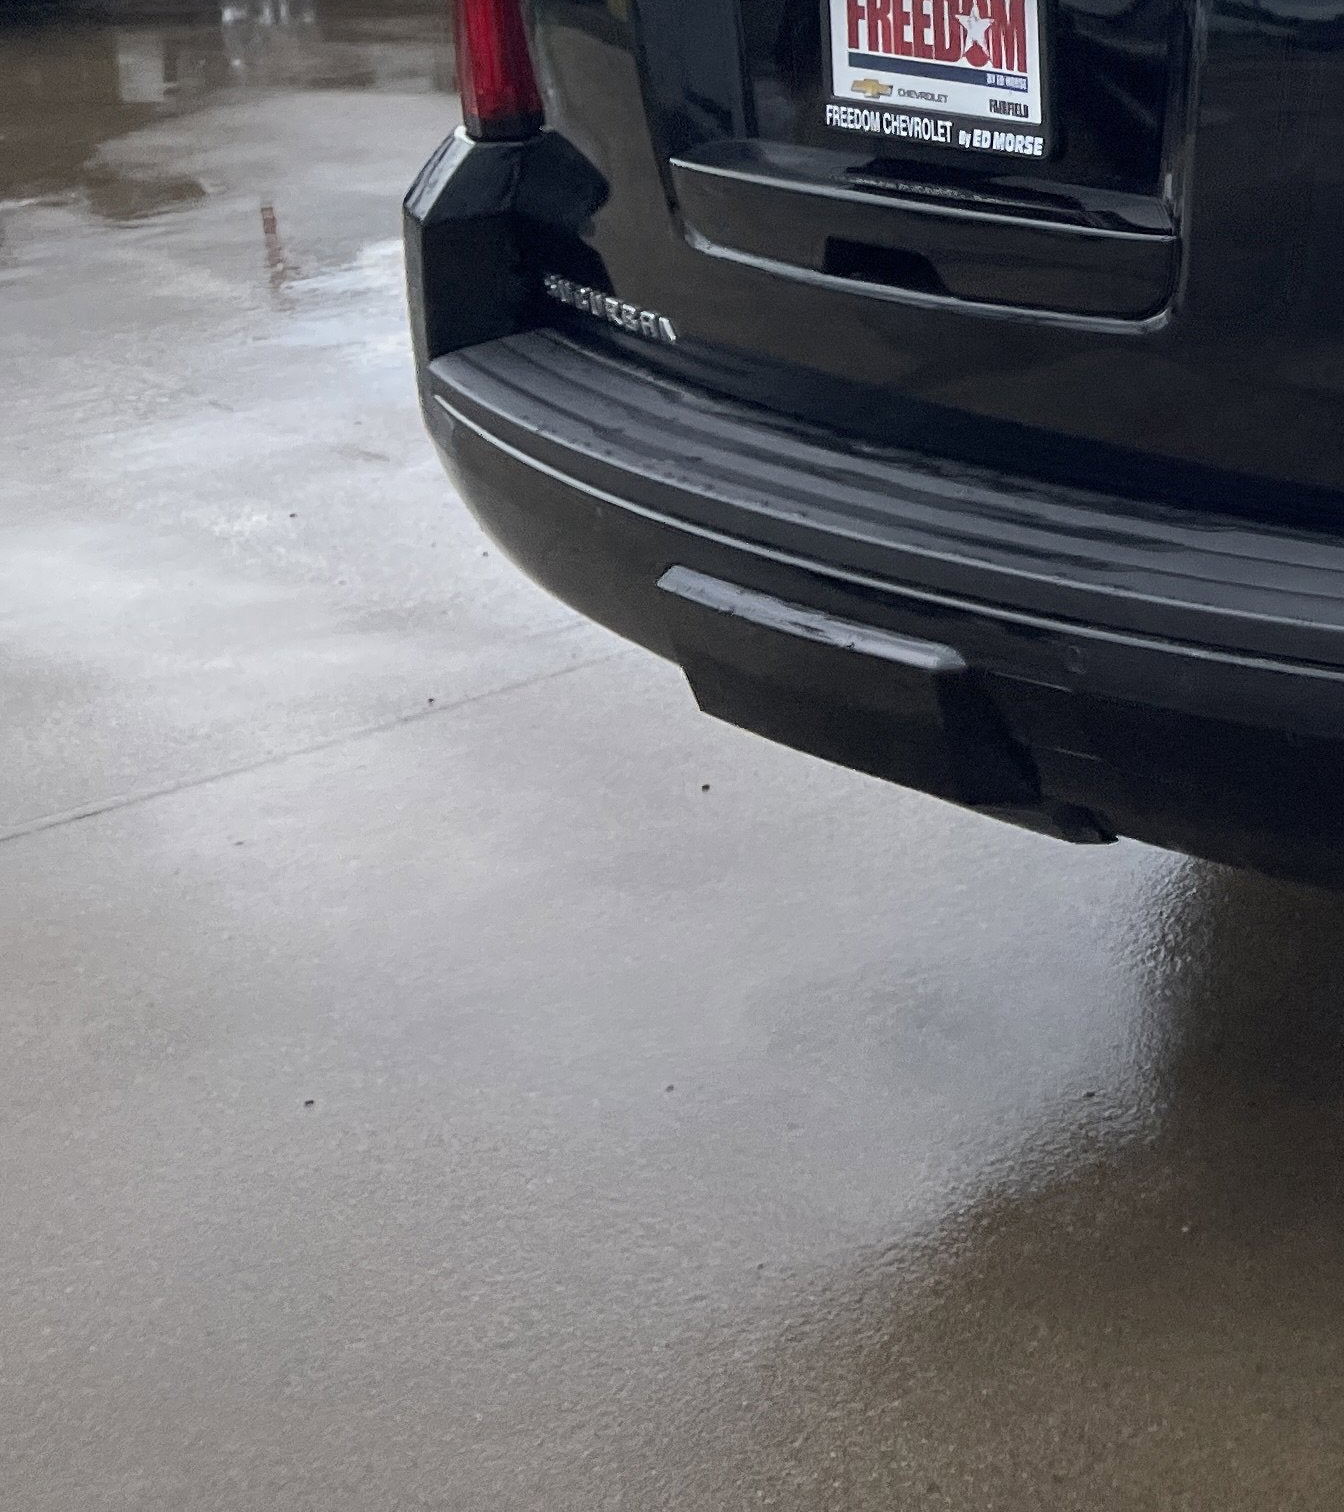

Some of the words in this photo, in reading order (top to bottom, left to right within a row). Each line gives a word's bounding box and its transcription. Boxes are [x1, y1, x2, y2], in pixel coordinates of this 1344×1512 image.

[898, 88, 948, 103] CHEVROLET
[826, 104, 881, 133] FREEDOM
[883, 112, 953, 144] CHEVROLET
[973, 129, 992, 148] ED
[993, 132, 1044, 156] MORSE
